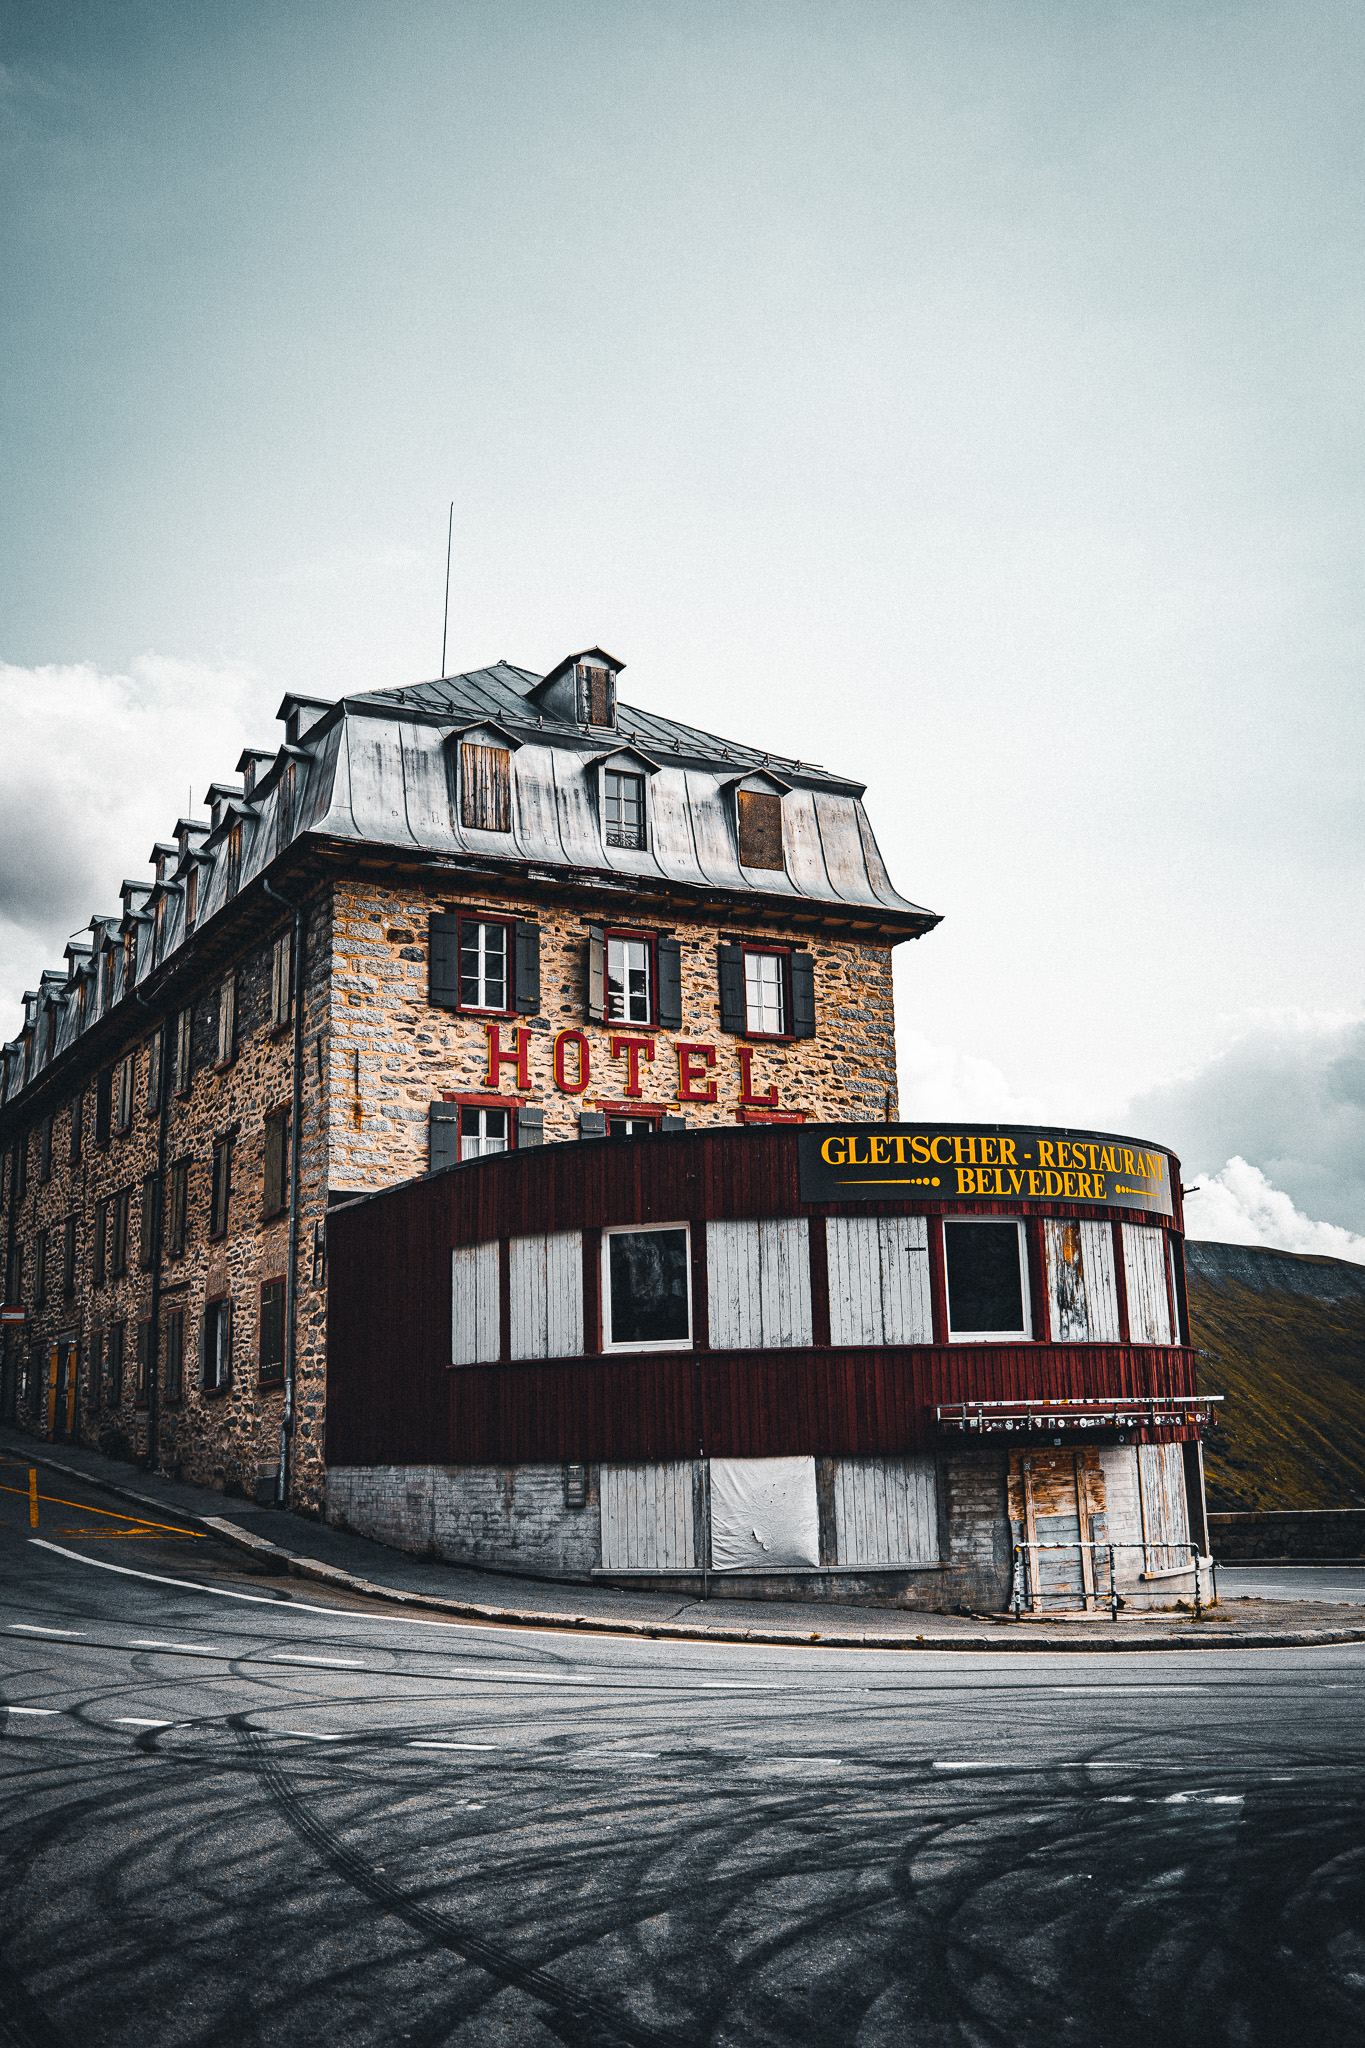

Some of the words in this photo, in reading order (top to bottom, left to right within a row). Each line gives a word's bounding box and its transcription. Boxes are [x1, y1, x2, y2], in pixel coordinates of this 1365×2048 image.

[484, 1024, 779, 1107] HOTEL
[820, 1136, 1019, 1166] GLETSCHER
[1039, 1140, 1164, 1182] RESTAURANT
[955, 1167, 1108, 1200] BELVEDERE
